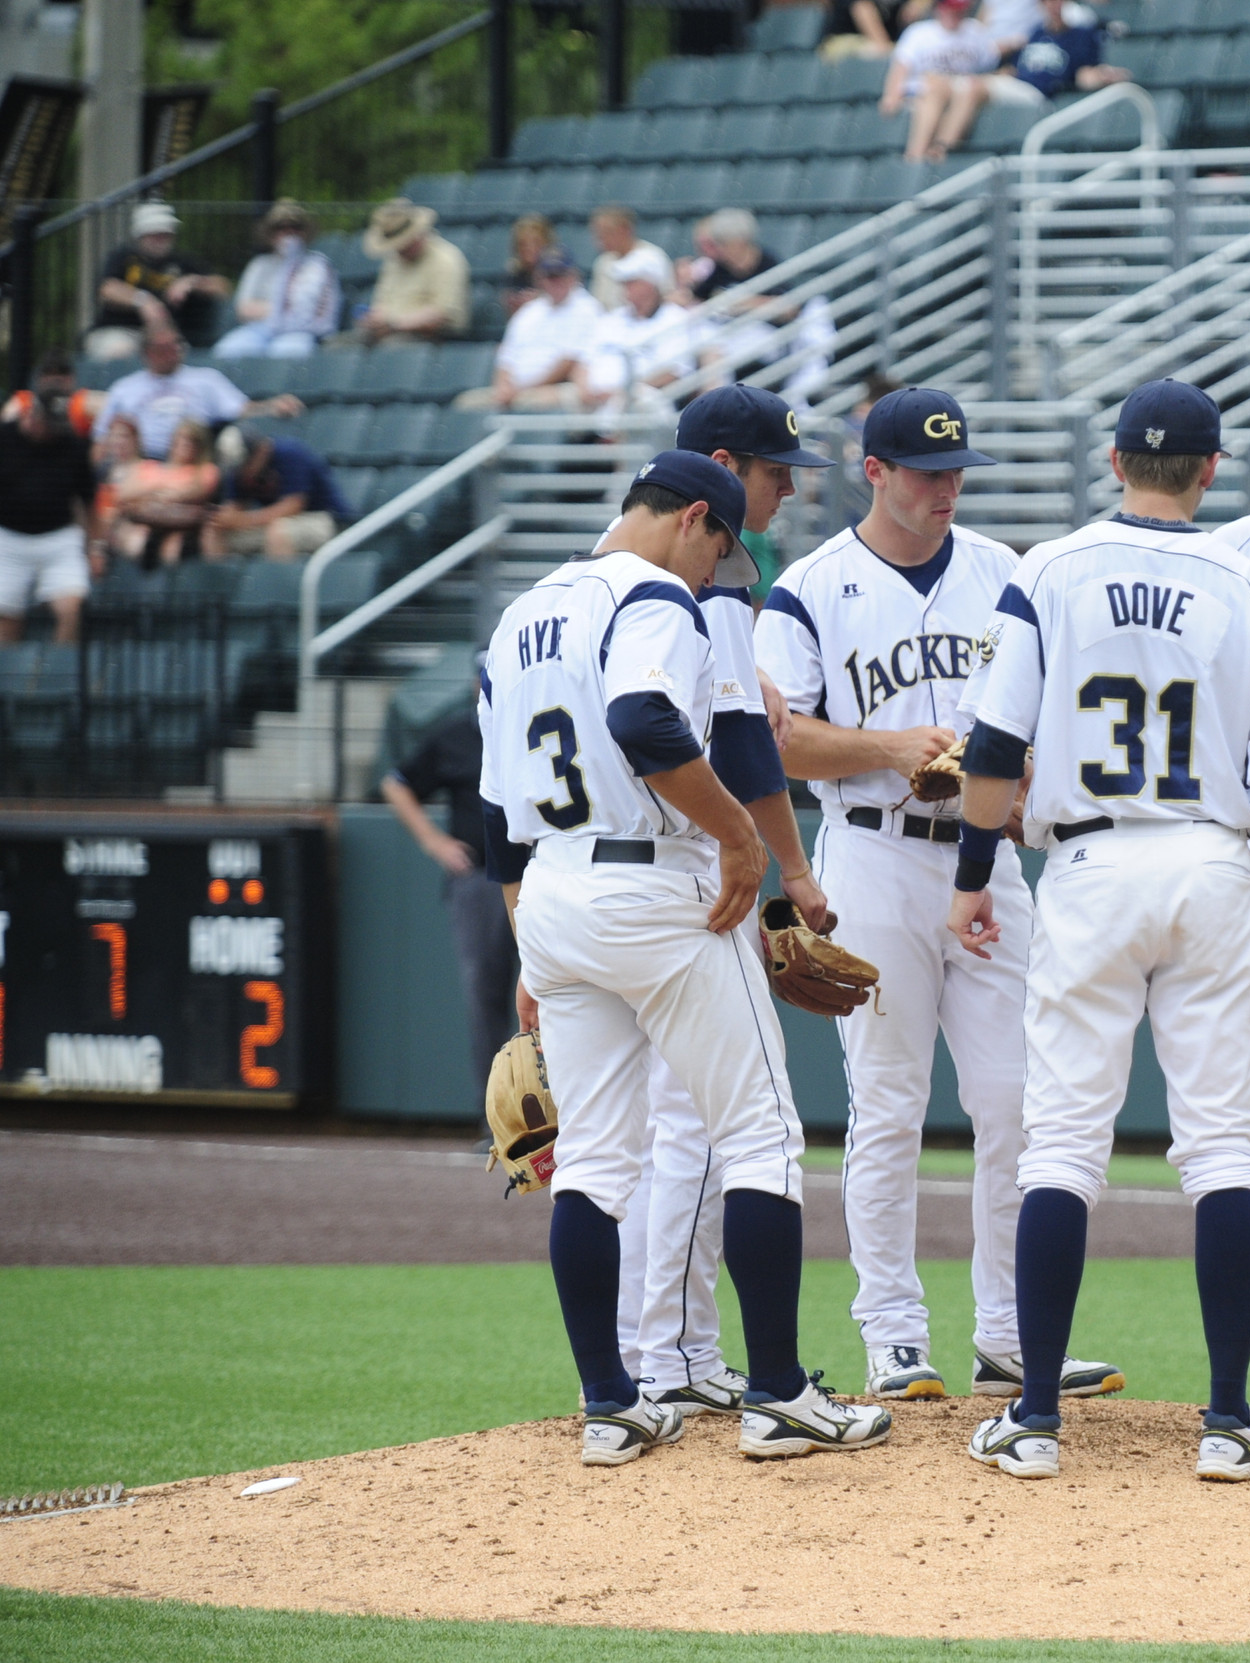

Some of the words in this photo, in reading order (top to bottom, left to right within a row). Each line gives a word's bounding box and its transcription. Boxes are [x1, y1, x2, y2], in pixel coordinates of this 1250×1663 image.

[924, 412, 962, 441] GT
[1106, 581, 1195, 636] DOVE
[518, 616, 569, 671] HYDE
[527, 704, 594, 832] 3
[1077, 672, 1201, 803] 31
[188, 915, 285, 976] HOME
[46, 1031, 163, 1095] INNING
[239, 980, 285, 1089] 2
